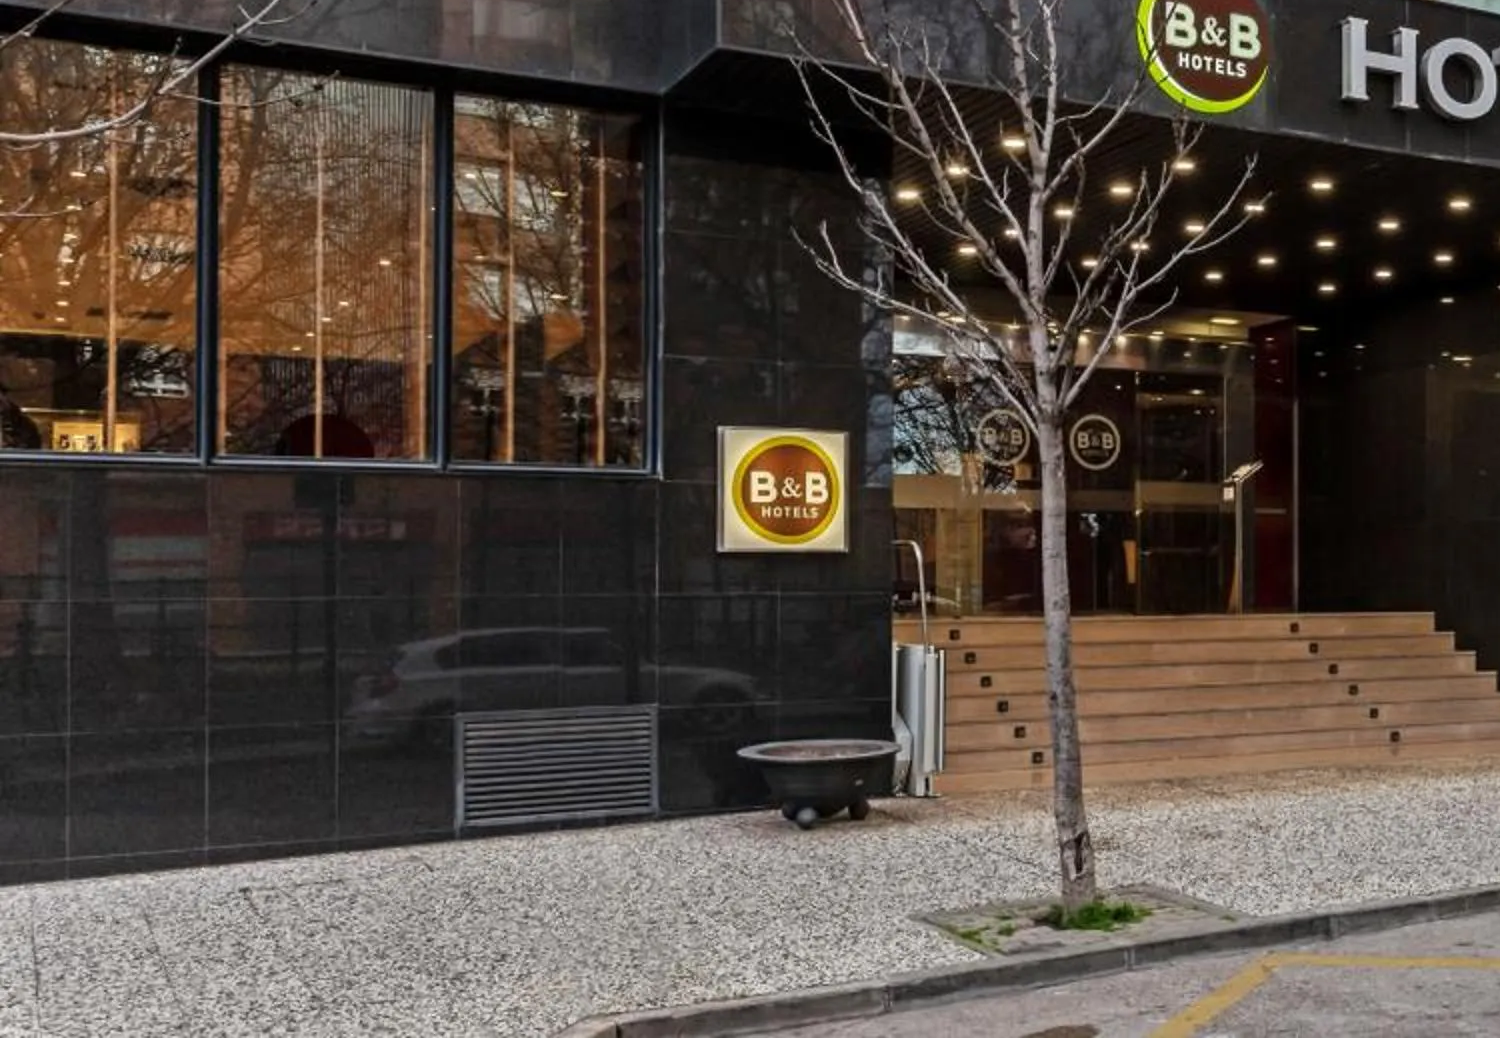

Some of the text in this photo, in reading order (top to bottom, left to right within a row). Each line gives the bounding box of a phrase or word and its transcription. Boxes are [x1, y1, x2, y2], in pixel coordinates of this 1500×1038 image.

[1165, 1, 1261, 60] B&B
[1178, 52, 1247, 78] HOTELS
[1077, 431, 1114, 449] B&B
[750, 470, 829, 504] B&B
[760, 505, 819, 519] HOTELS
